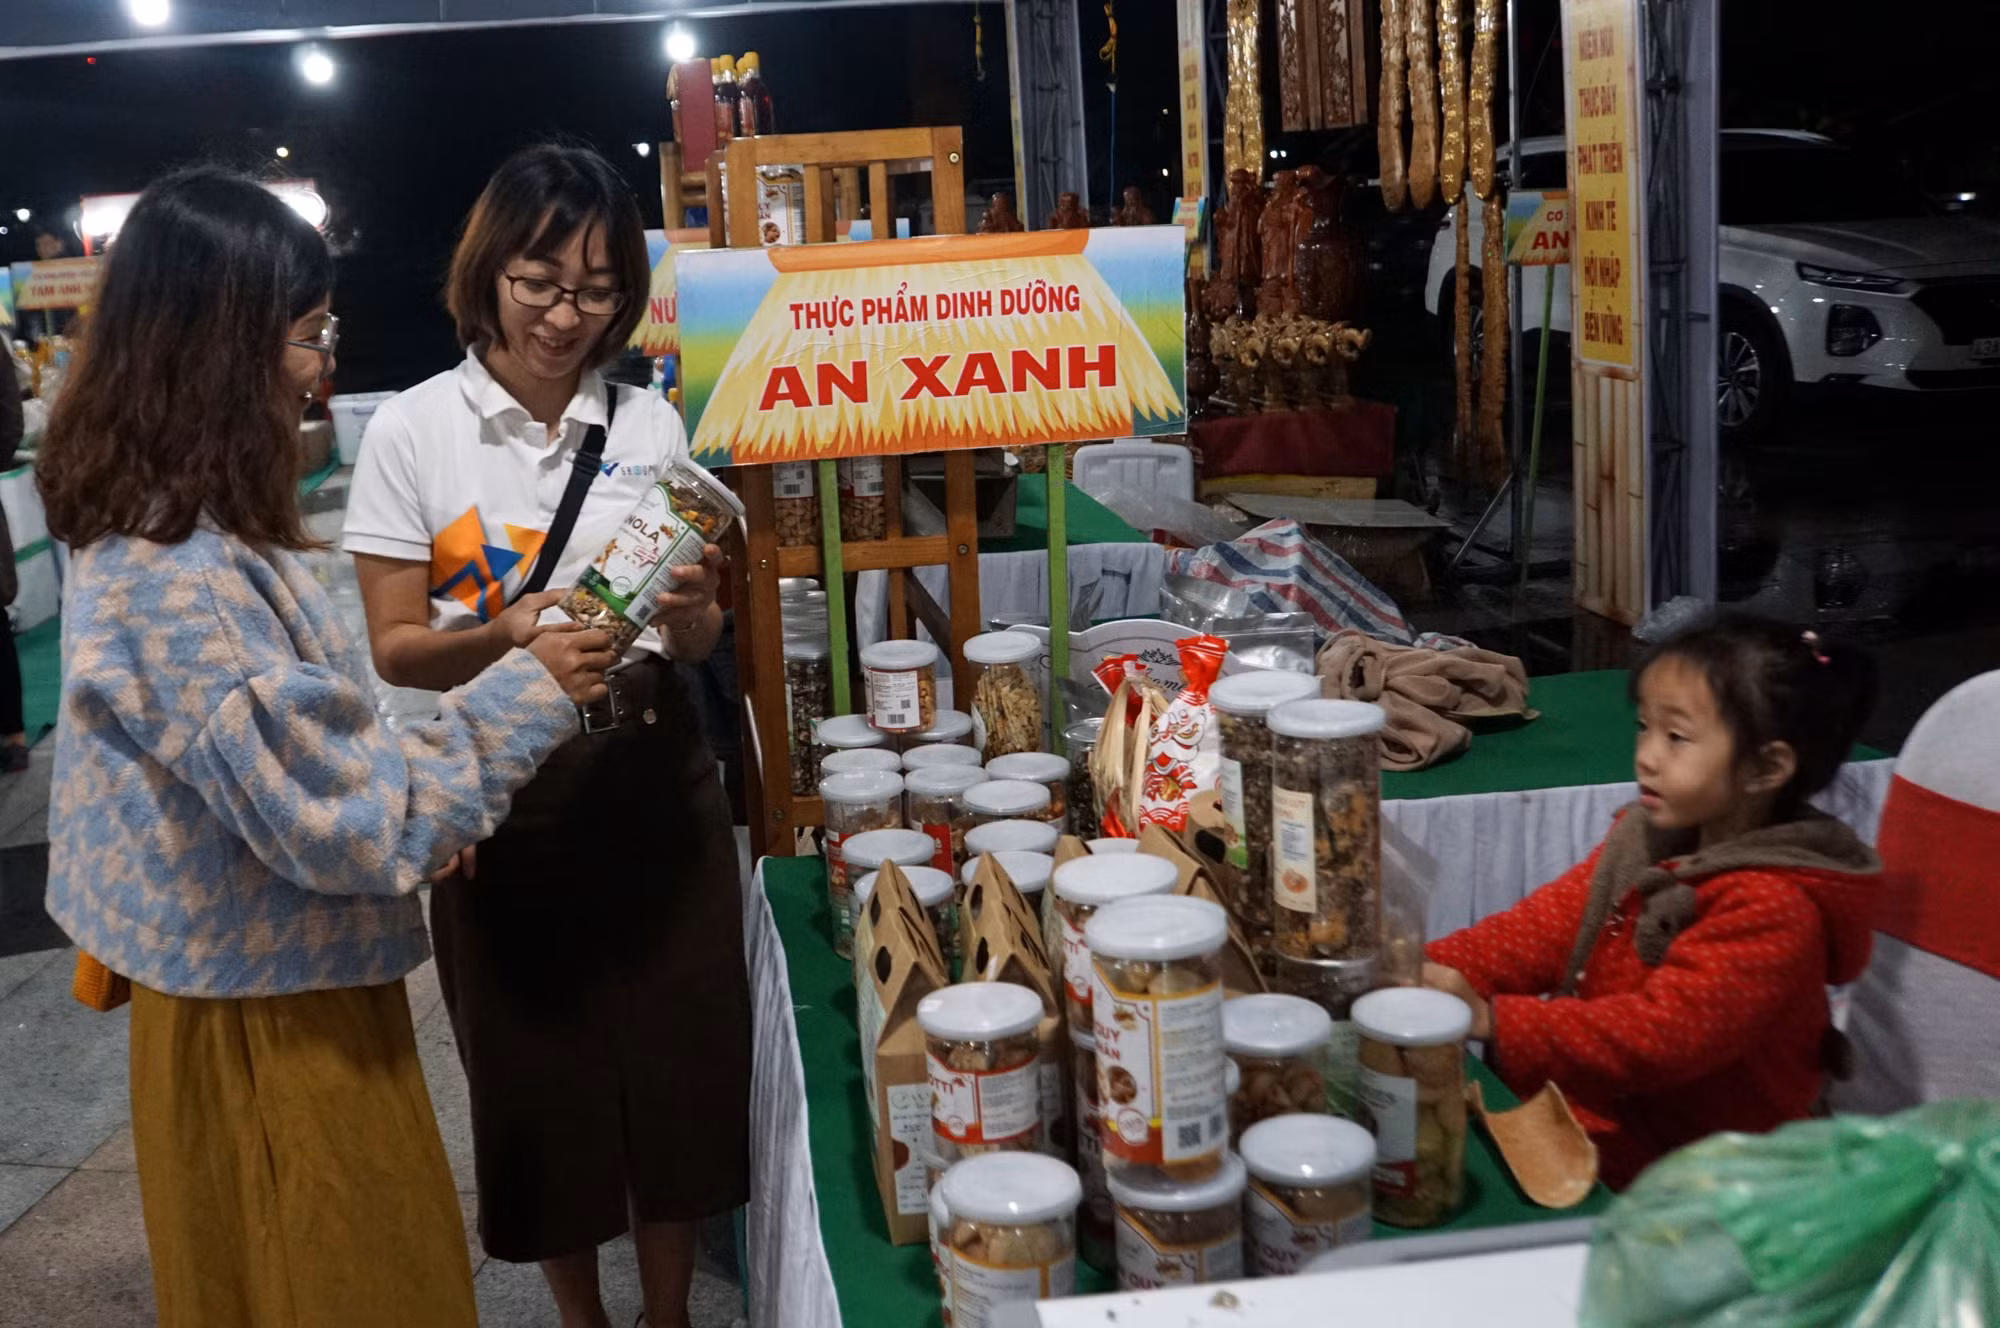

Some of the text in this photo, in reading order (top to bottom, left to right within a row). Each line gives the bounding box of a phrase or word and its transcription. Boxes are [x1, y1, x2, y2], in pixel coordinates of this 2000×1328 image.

[1585, 201, 1604, 231] KINH
[789, 279, 1080, 336] THỰC PHẨM DINH DƯỠNG
[758, 344, 1118, 411] AN XANH
[624, 514, 660, 544] NOLA
